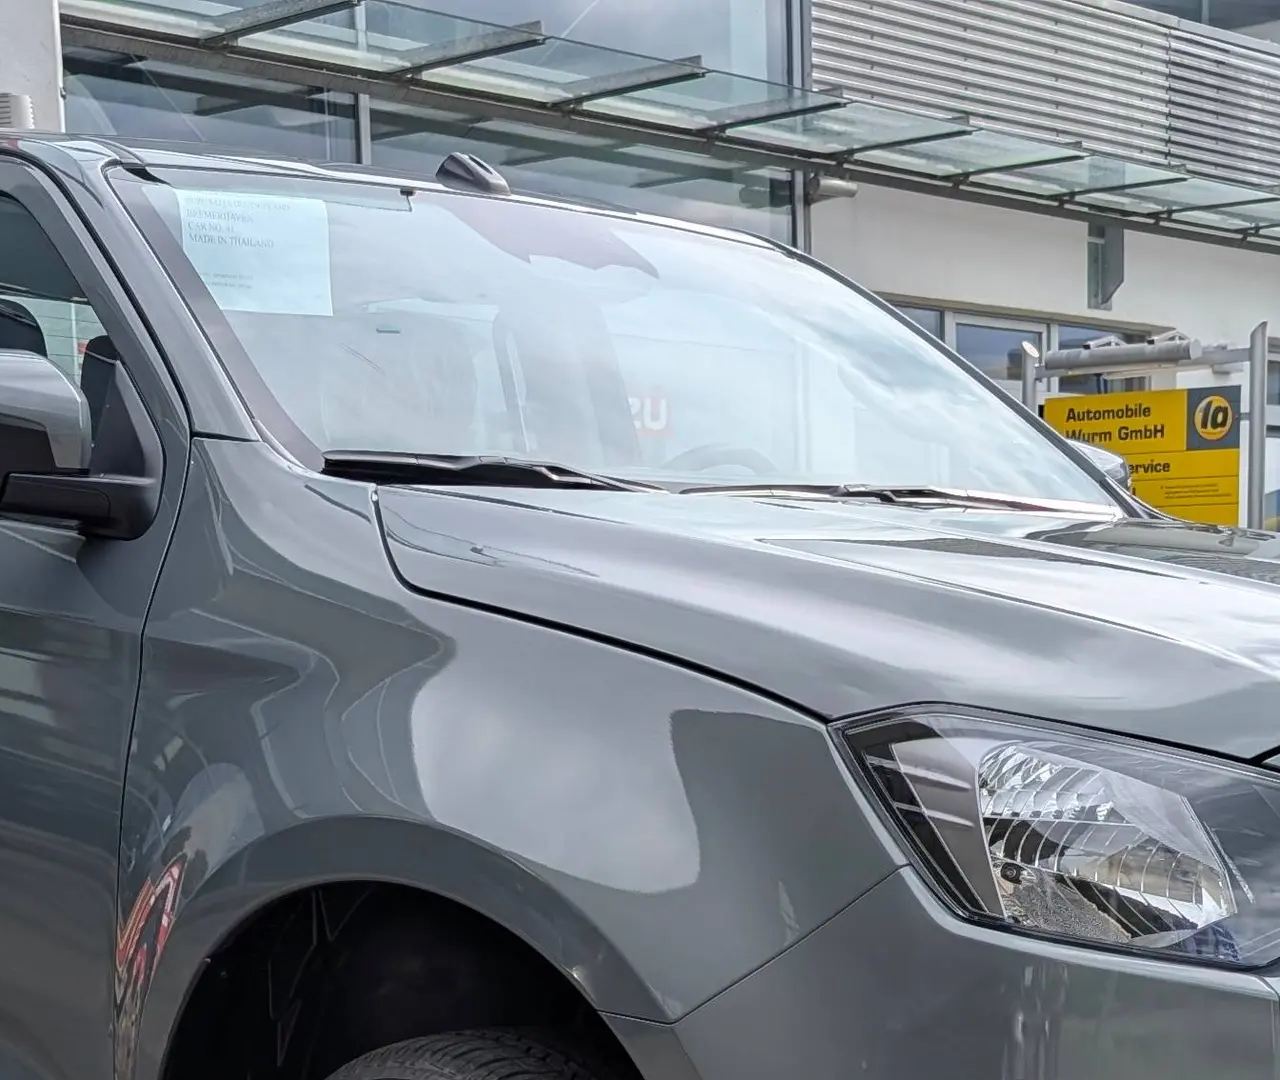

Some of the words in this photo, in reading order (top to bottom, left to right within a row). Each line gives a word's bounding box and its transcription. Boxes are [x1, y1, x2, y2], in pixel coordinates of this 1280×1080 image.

[188, 222, 207, 232] CAR
[189, 233, 214, 244] MADE
[217, 235, 227, 245] IN
[229, 236, 275, 248] THAILAND
[1065, 403, 1151, 423] Automobile
[1065, 428, 1112, 443] Wurm
[1117, 424, 1165, 441] GmbH
